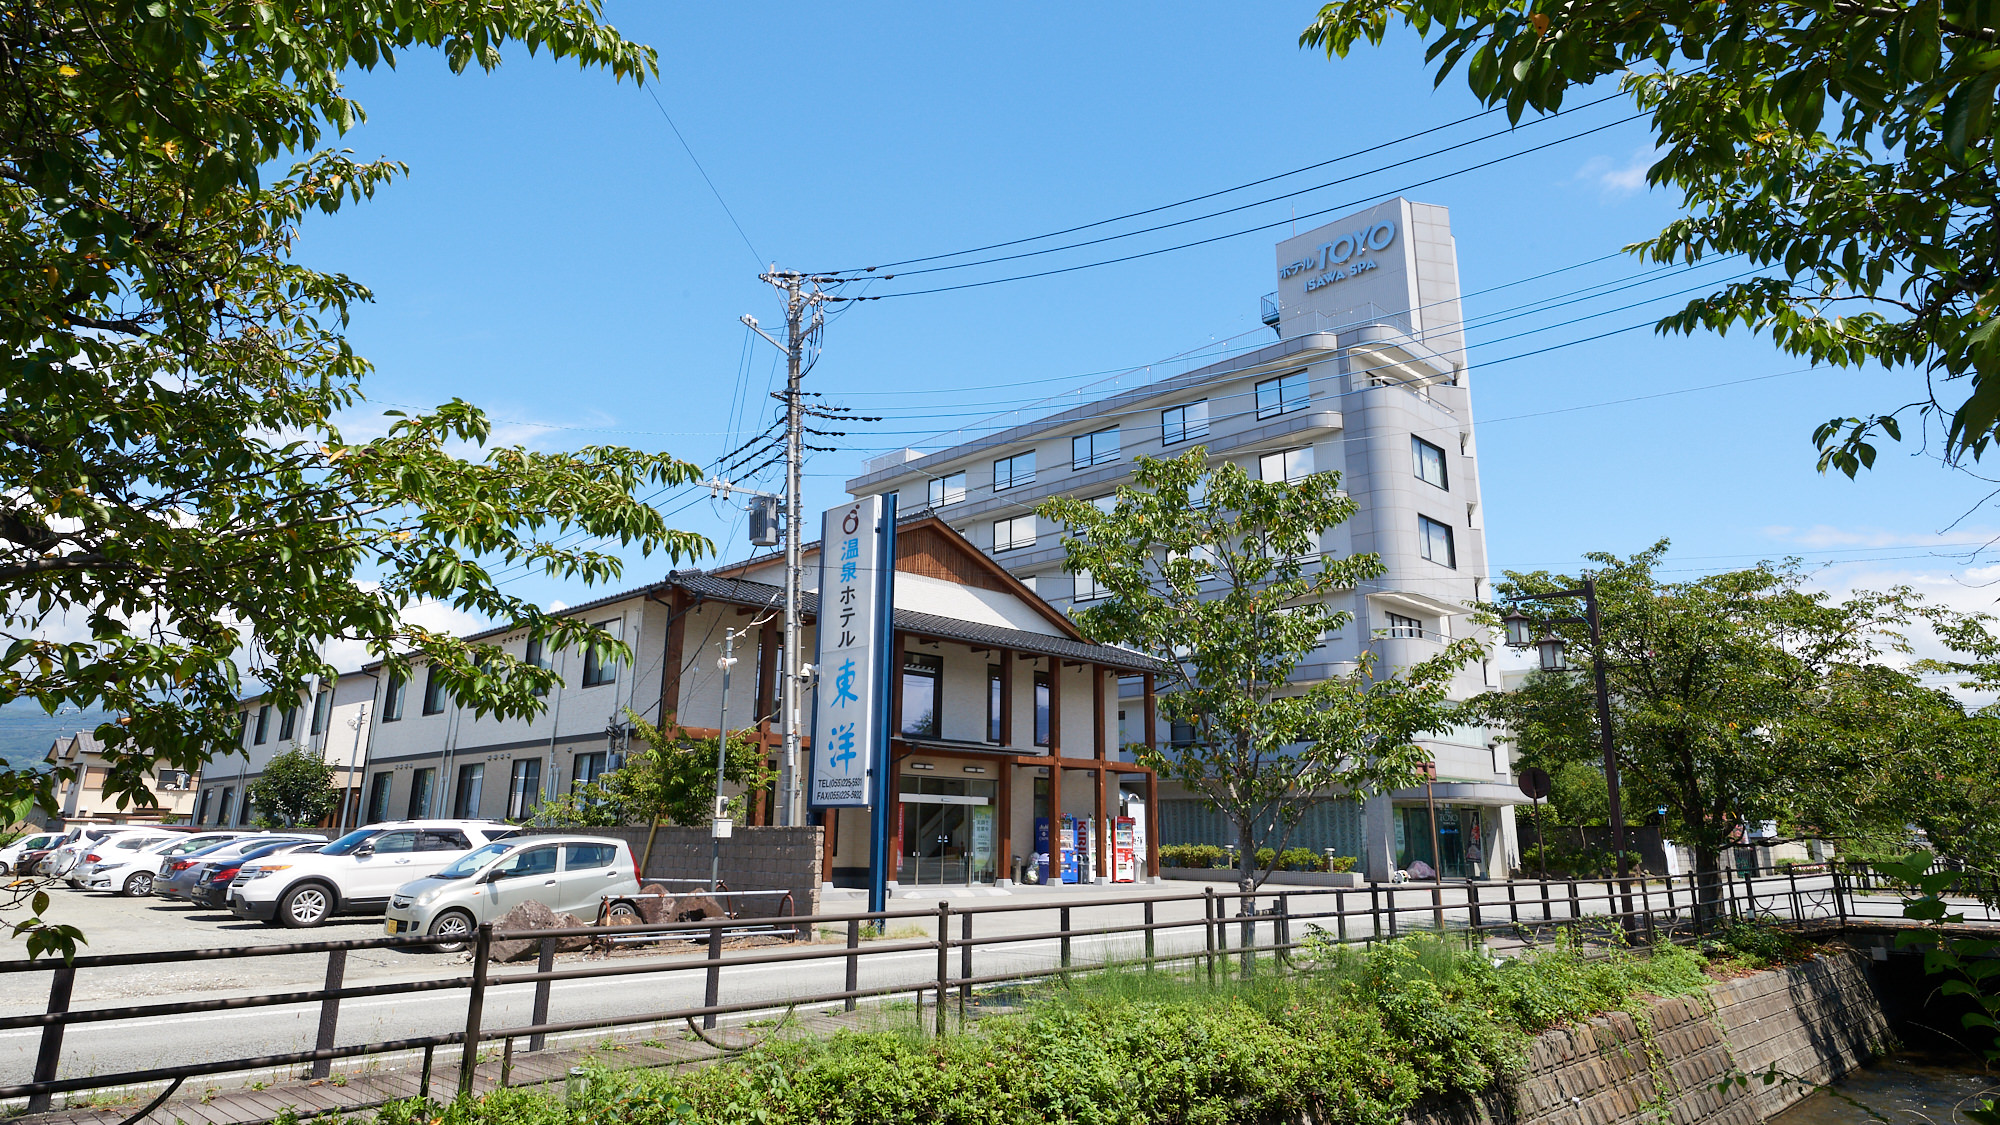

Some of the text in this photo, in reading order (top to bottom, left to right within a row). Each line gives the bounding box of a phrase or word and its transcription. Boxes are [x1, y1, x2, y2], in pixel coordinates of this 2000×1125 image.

[1280, 219, 1395, 279] ホテル TOYO
[1304, 258, 1377, 293] ISAWA SPA
[828, 537, 859, 776] 温泉ホテル 東洋
[1078, 821, 1086, 855] KIRI
